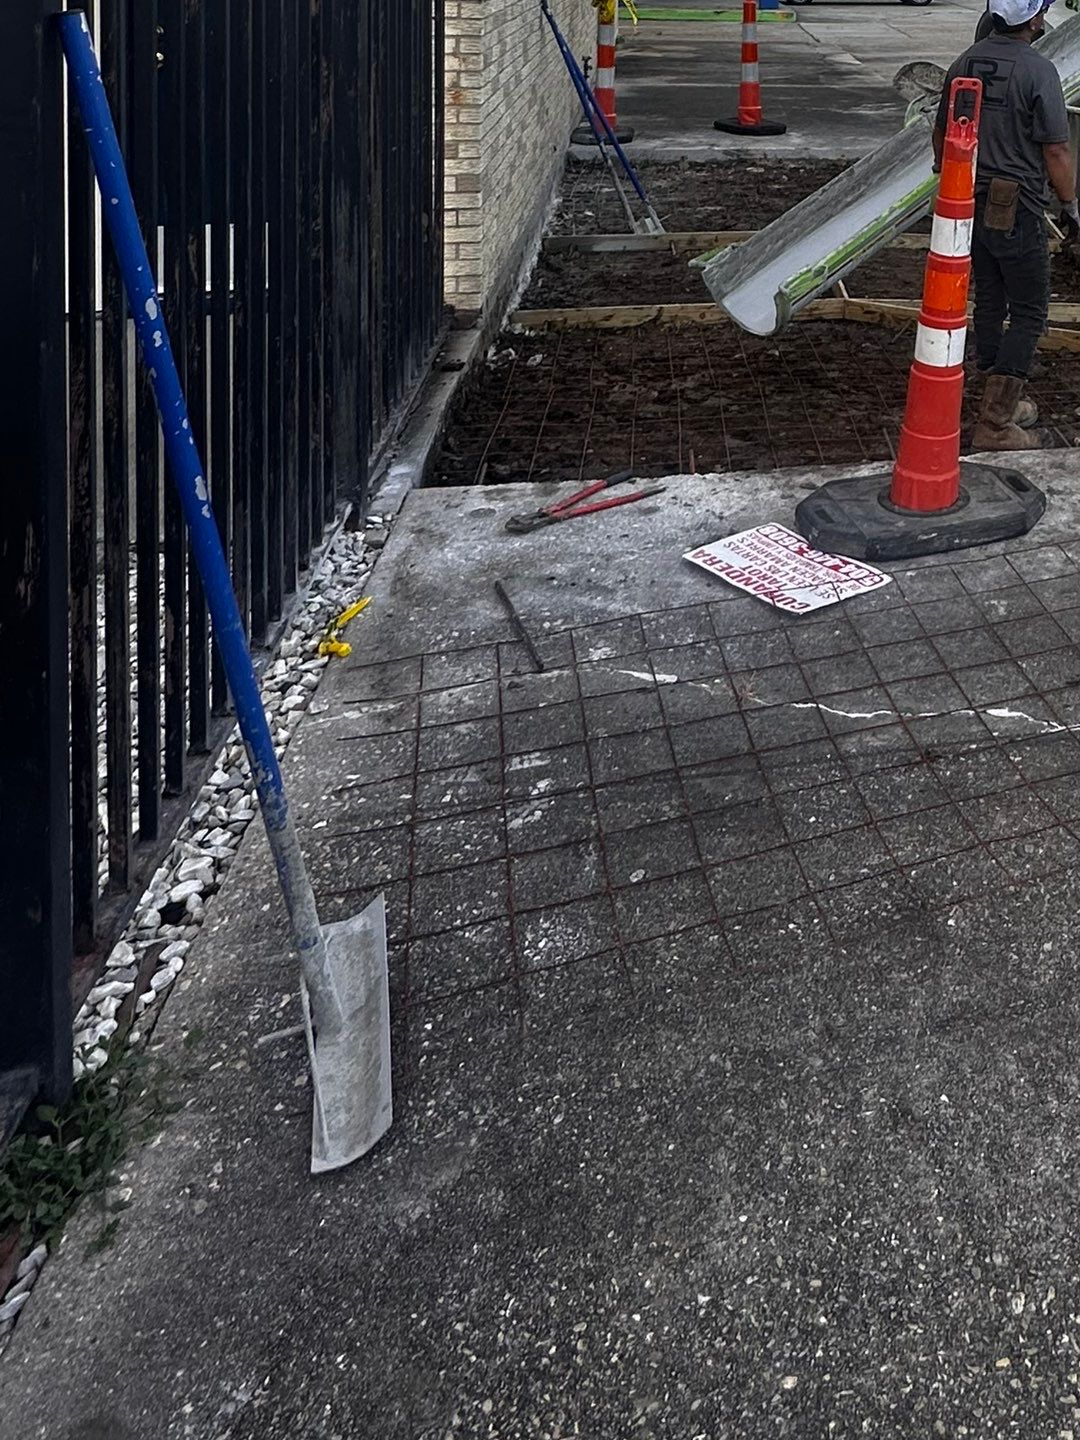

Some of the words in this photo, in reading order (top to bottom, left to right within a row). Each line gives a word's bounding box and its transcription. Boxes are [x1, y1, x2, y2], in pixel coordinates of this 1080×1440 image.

[720, 541, 768, 566] CARTAS
[692, 549, 811, 610] CURANDERA
[737, 564, 788, 589] TAROT
[762, 564, 790, 577] LAS
